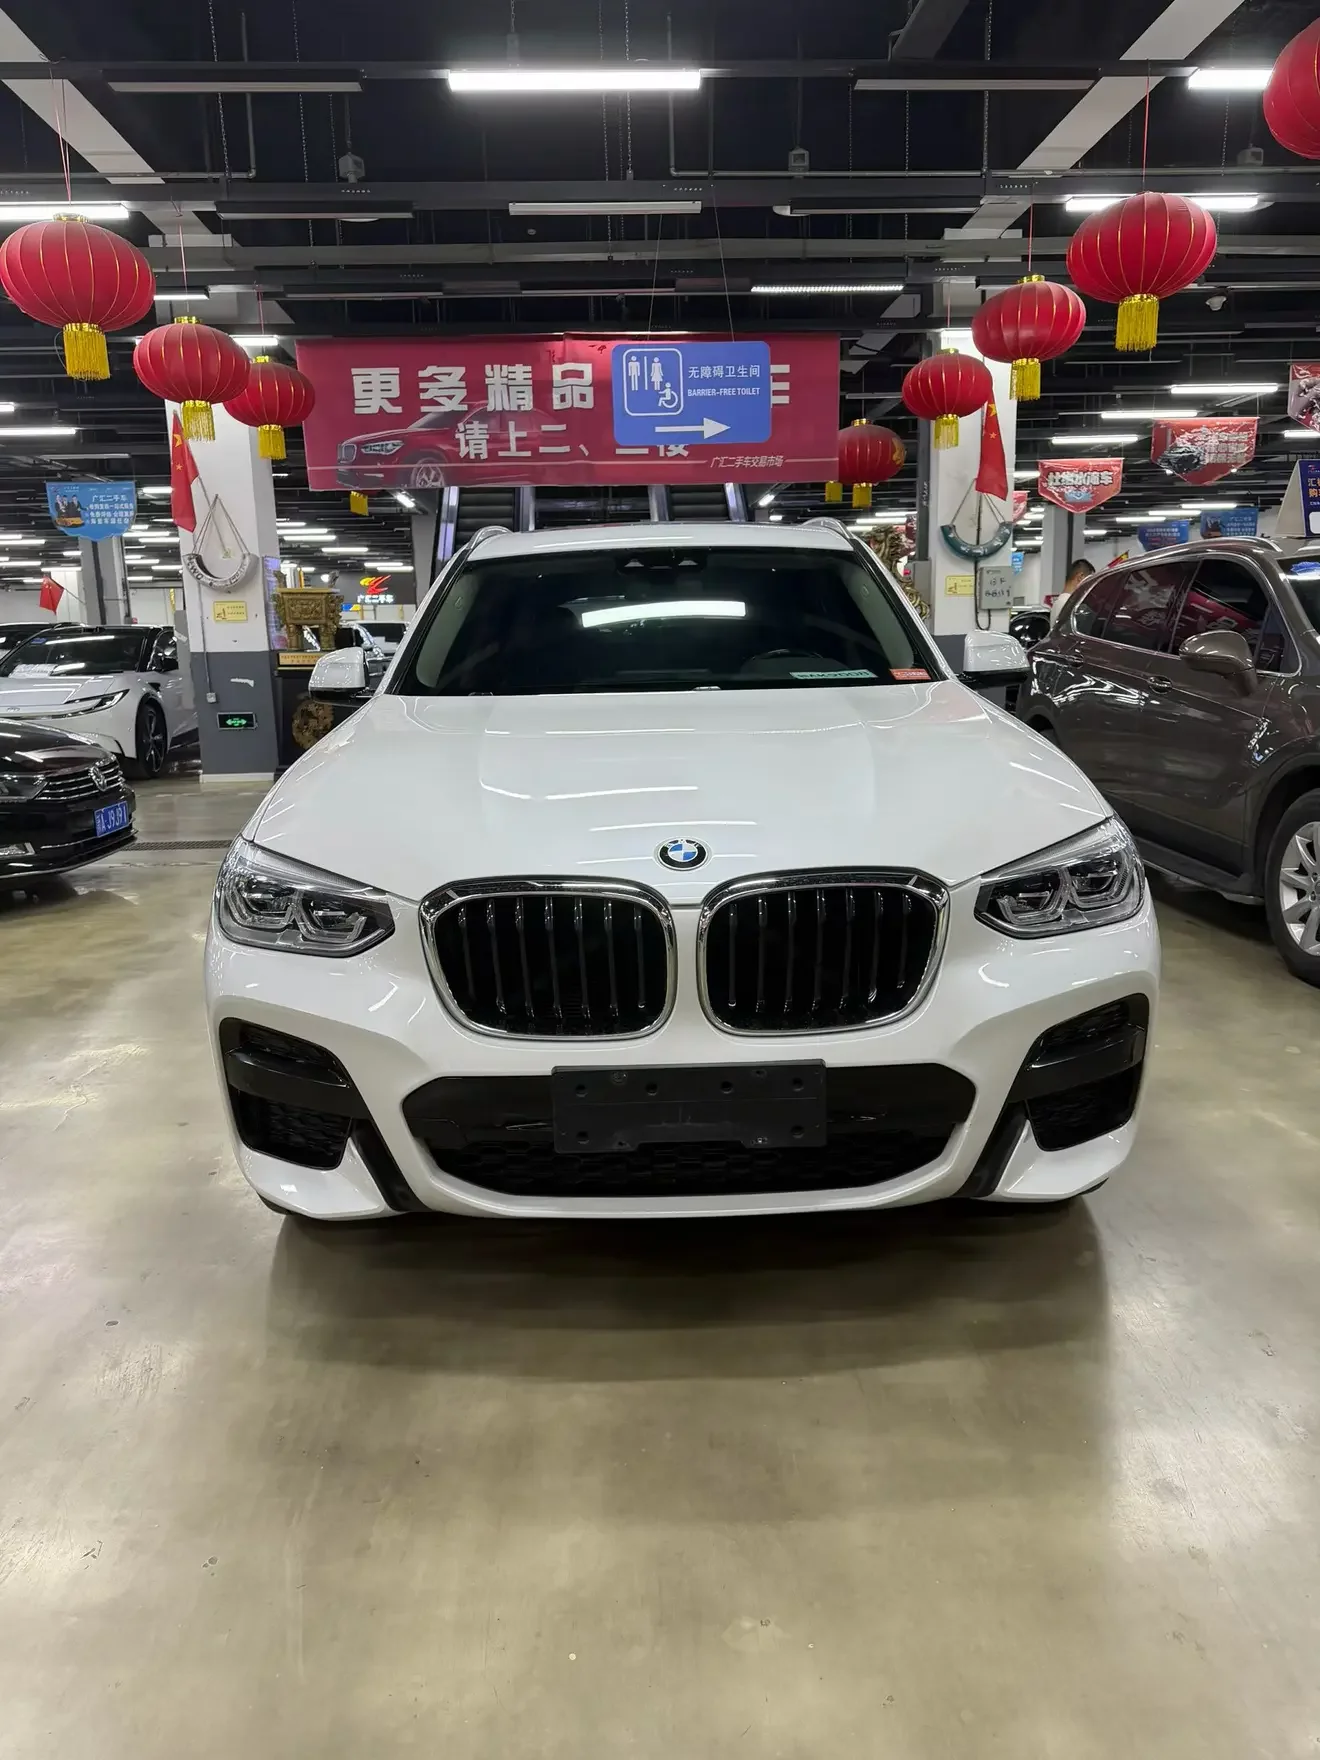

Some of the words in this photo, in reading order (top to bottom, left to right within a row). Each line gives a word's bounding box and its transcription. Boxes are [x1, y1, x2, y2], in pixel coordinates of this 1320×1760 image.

[688, 364, 761, 379] 无障碍卫生间
[687, 387, 736, 397] BARRIER-FREE
[736, 387, 761, 396] TOILET
[710, 455, 784, 469] 广汇二手车交易市场
